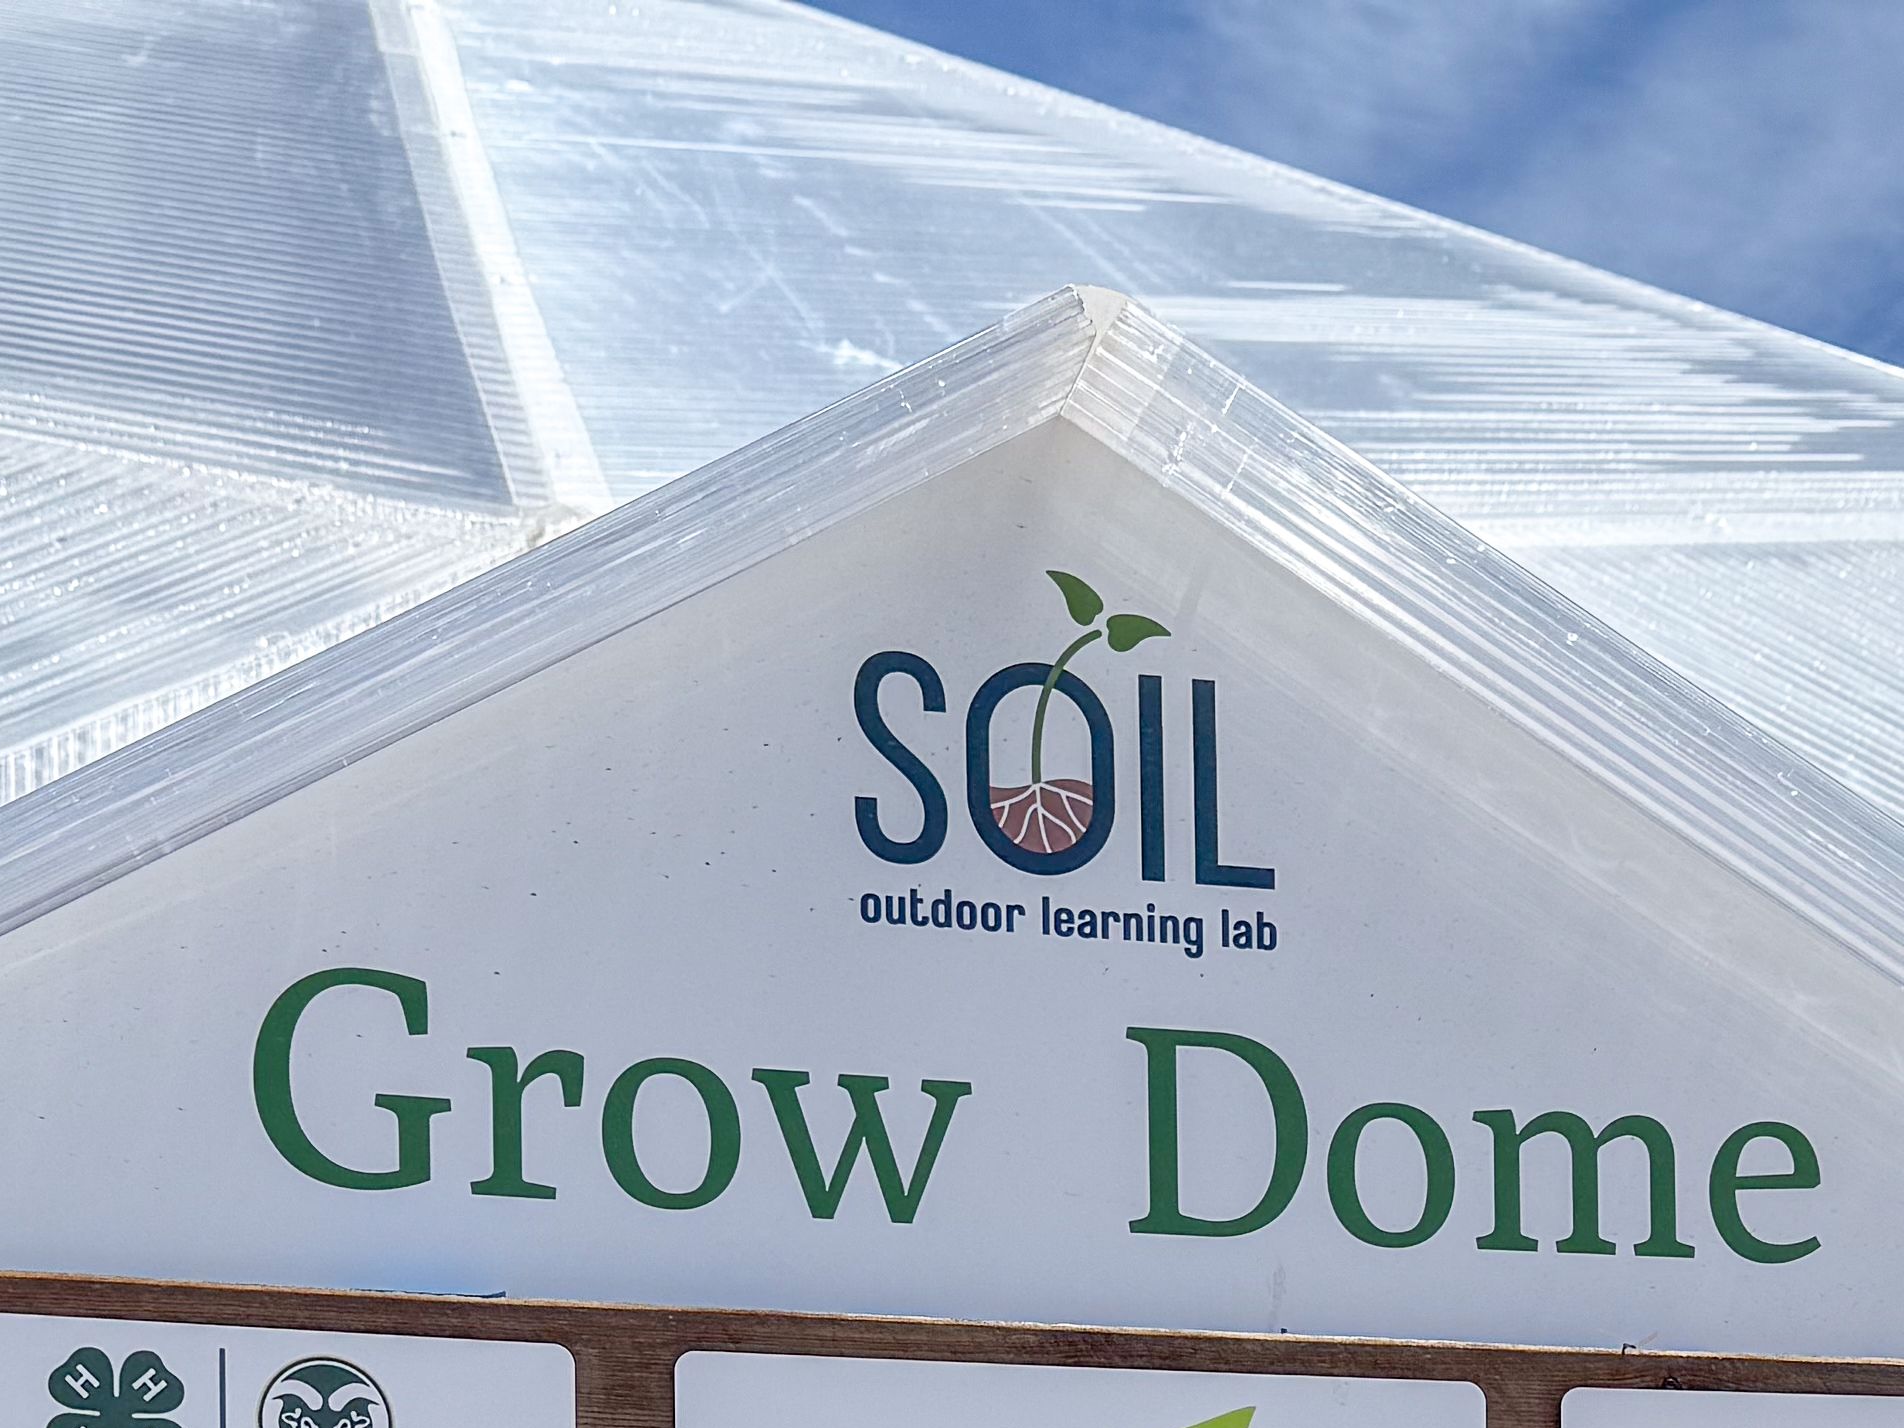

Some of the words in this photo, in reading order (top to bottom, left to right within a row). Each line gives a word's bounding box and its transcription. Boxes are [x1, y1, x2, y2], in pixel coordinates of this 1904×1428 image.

[853, 650, 1275, 889] SOIL
[860, 889, 1026, 933] outdoor
[1041, 896, 1204, 959] learning
[1222, 909, 1276, 950] lab
[253, 968, 972, 1224] Grow
[1126, 1027, 1821, 1264] Dome
